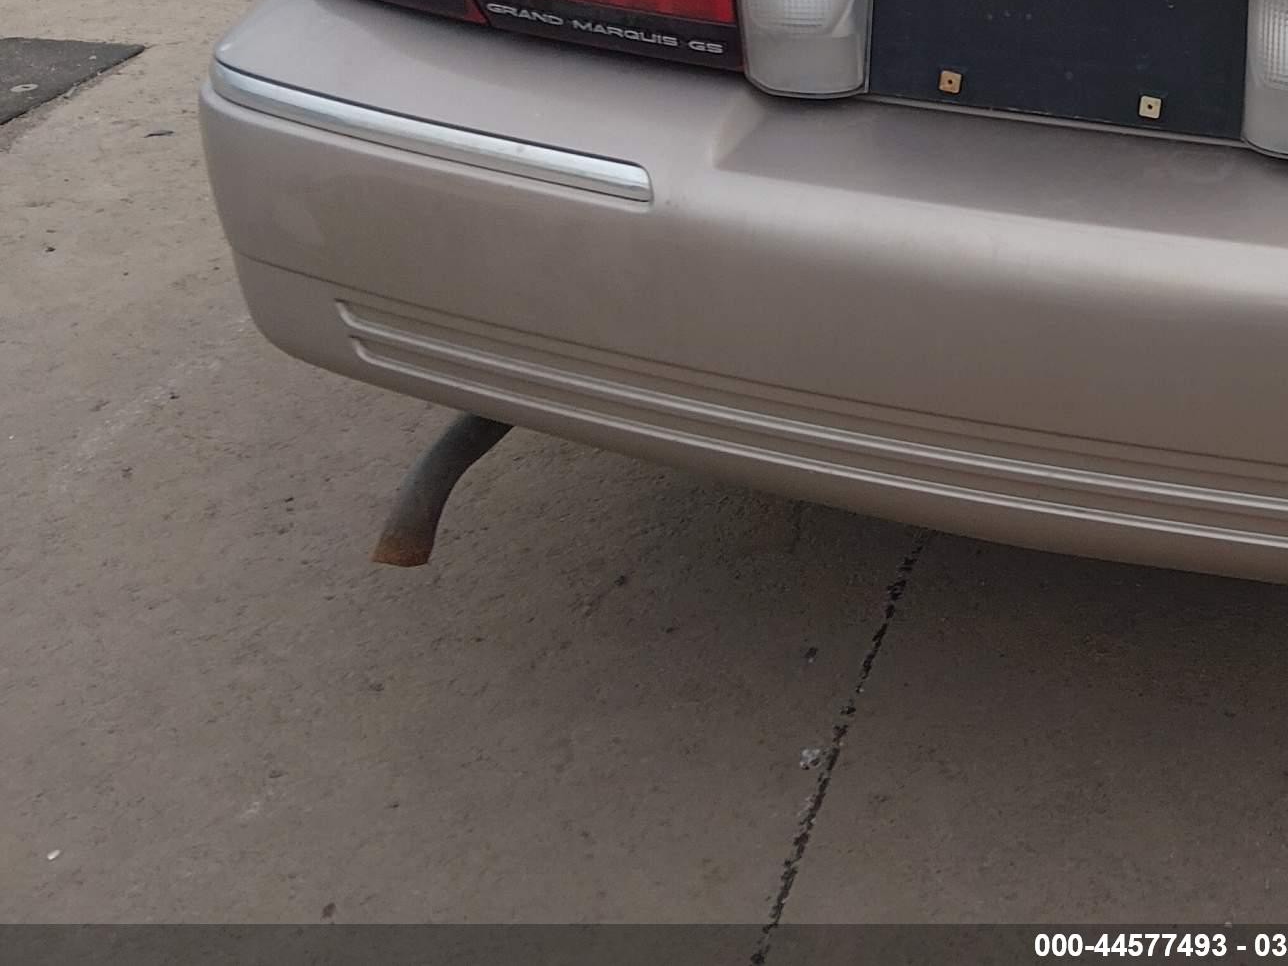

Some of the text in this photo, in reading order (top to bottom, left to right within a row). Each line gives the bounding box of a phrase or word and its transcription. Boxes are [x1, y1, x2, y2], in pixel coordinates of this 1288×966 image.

[486, 3, 724, 54] GRAND MARQUIS GS
